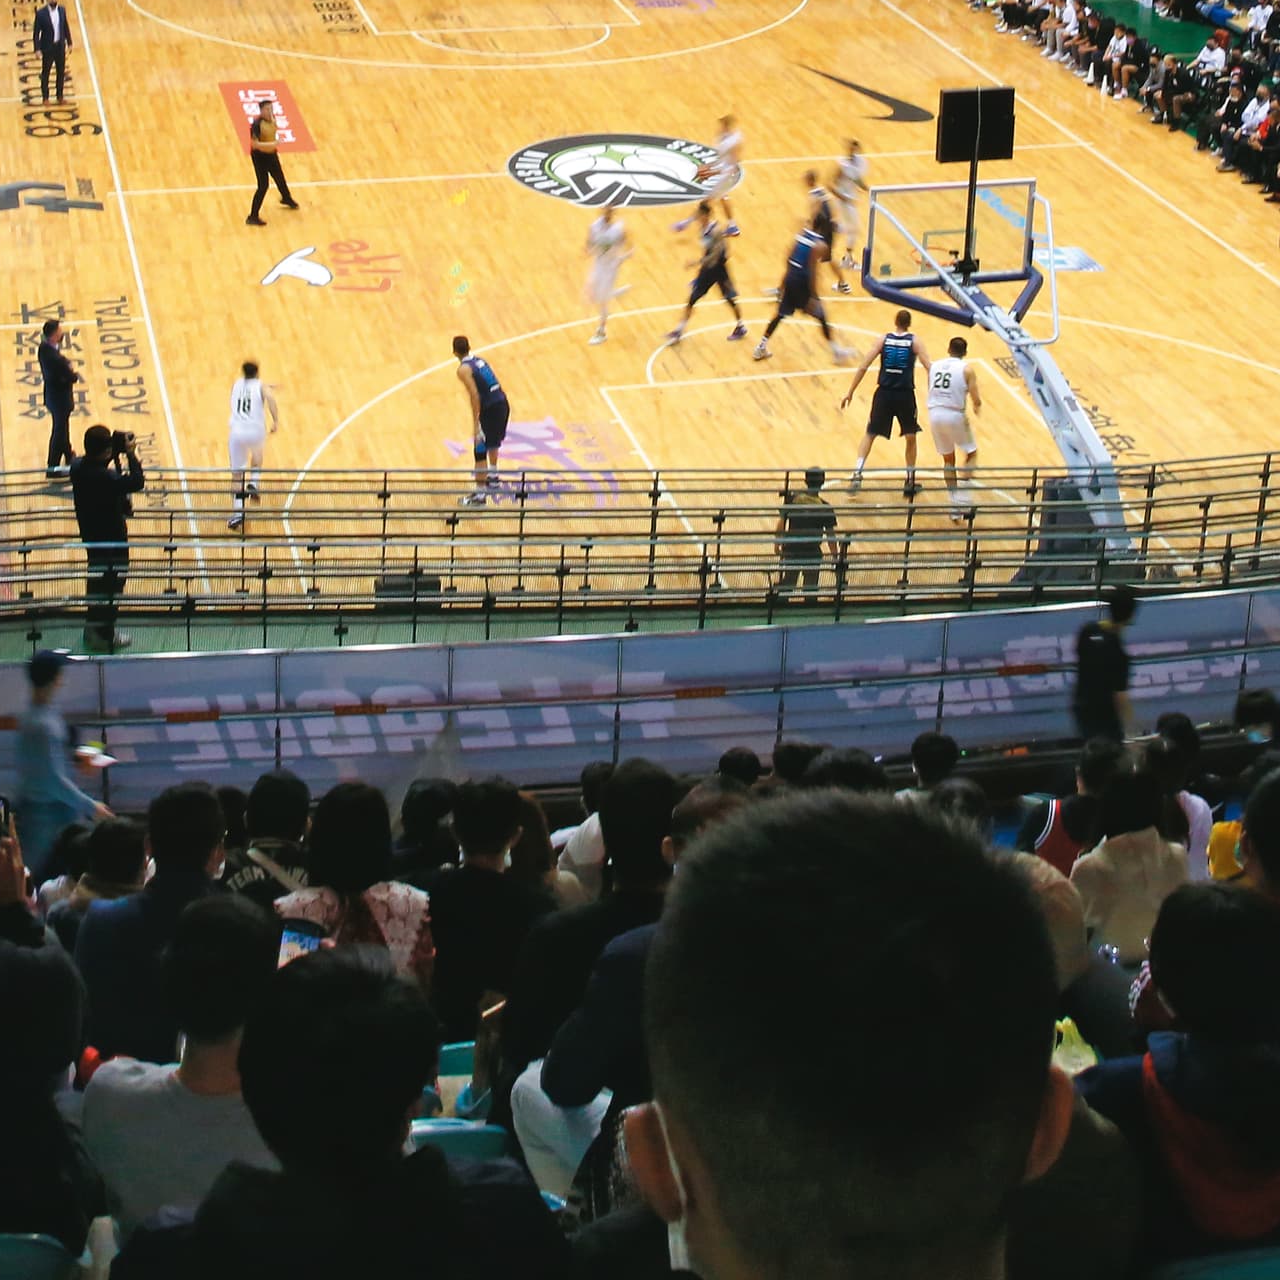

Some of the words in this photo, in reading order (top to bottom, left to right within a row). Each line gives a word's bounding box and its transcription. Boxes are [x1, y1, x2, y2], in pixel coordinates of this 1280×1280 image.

[94, 295, 140, 370] CAPITAL
[107, 377, 150, 415] ACE
[934, 371, 952, 390] 26
